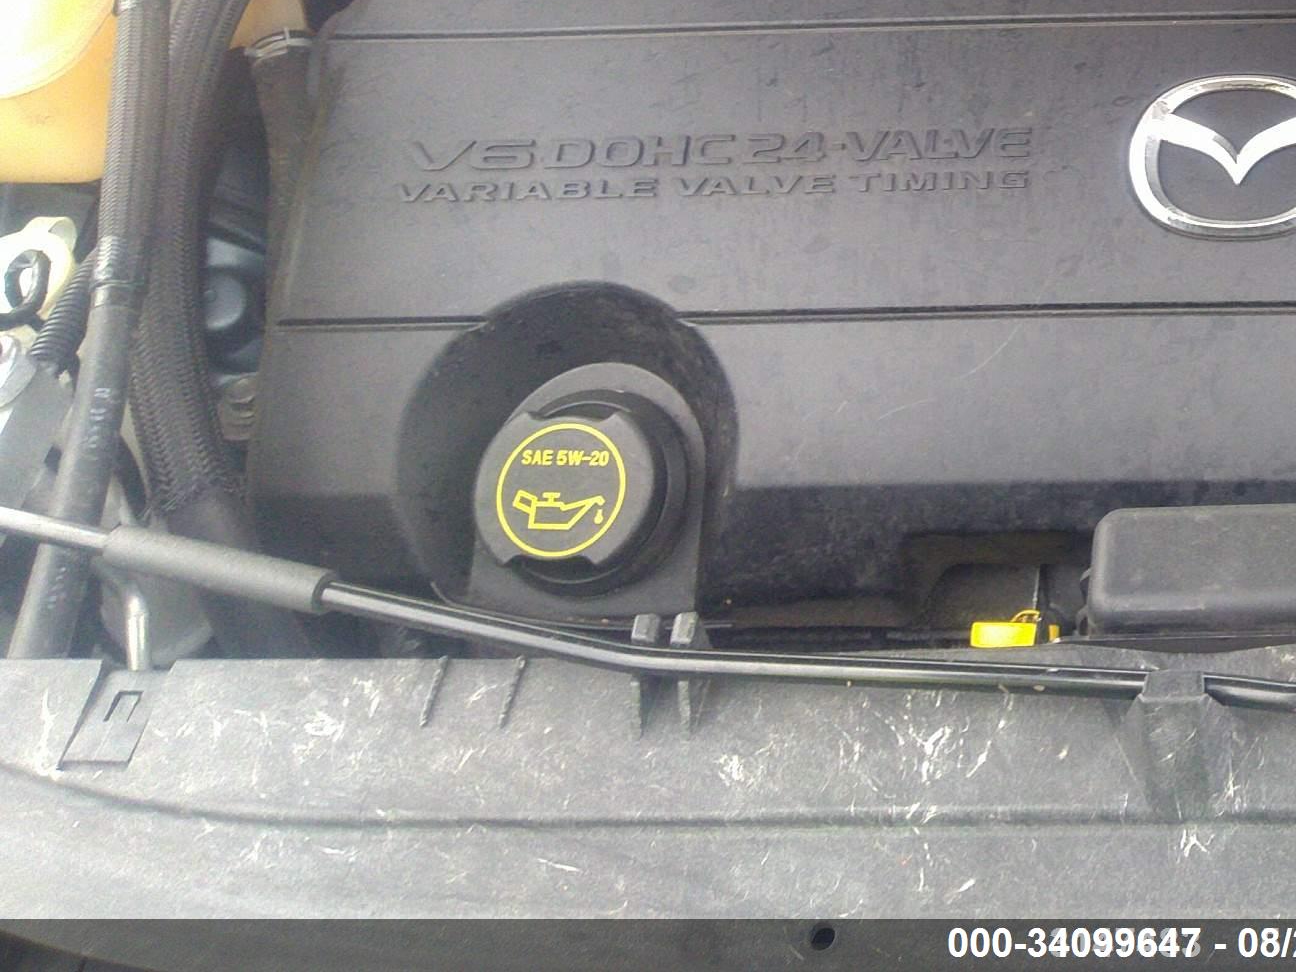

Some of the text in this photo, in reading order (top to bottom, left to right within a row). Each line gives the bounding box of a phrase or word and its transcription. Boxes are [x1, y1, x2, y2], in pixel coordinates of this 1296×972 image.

[412, 139, 536, 172] V6
[543, 134, 736, 169] DOHC
[397, 170, 1030, 203] VARIABLE VALVE TIMING
[521, 449, 610, 466] SAE 5W-20
